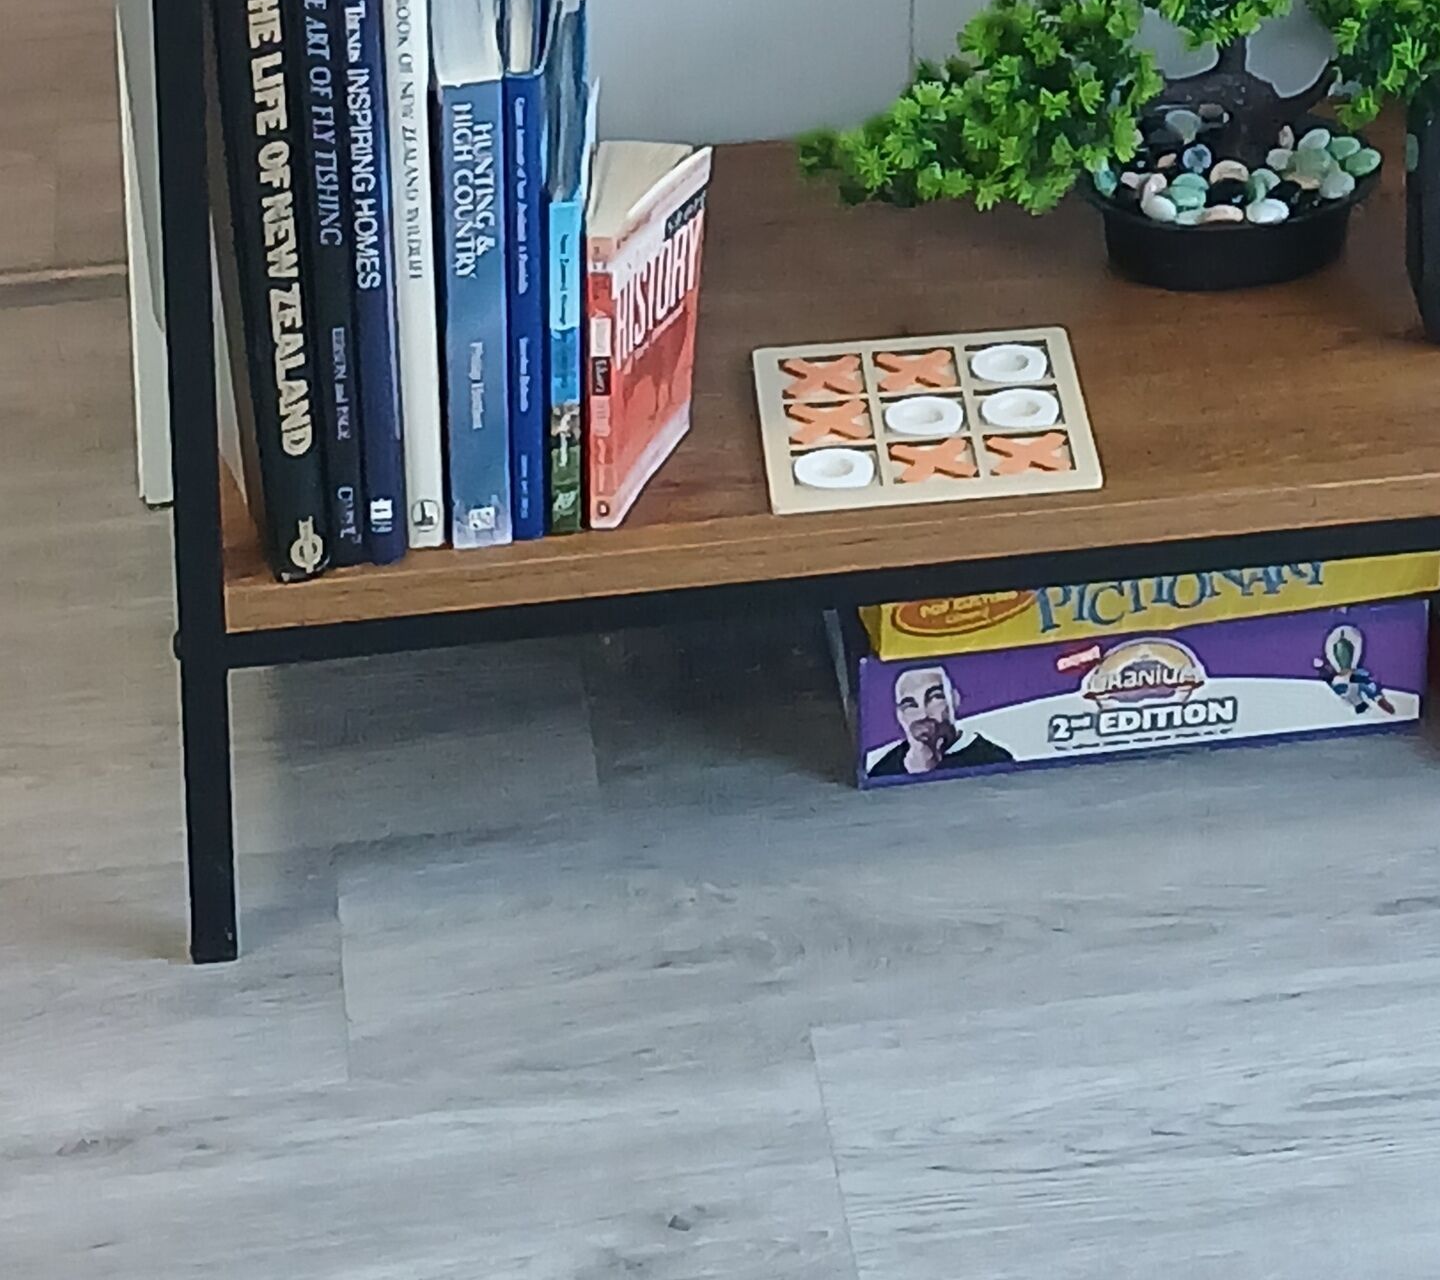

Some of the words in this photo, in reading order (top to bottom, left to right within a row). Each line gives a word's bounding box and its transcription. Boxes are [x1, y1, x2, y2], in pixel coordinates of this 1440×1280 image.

[305, 16, 330, 61] ART
[398, 51, 414, 75] OF
[251, 51, 288, 135] LIFE
[309, 66, 333, 100] OF
[400, 80, 415, 119] NEW
[311, 105, 336, 144] FLY
[346, 67, 376, 193] INSPIRING
[401, 124, 419, 201] ZEALAND
[451, 102, 474, 163] HIGH
[258, 140, 291, 191] OF
[315, 149, 343, 247] FISHING
[473, 121, 496, 229] HUNTING
[261, 190, 298, 278] NEW
[354, 198, 382, 290] HOMES
[453, 170, 478, 280] COUNTRY
[476, 234, 496, 257] &
[616, 208, 703, 370] HISTORY
[269, 281, 312, 456] ZEALAND
[1100, 700, 1234, 735] EDITION
